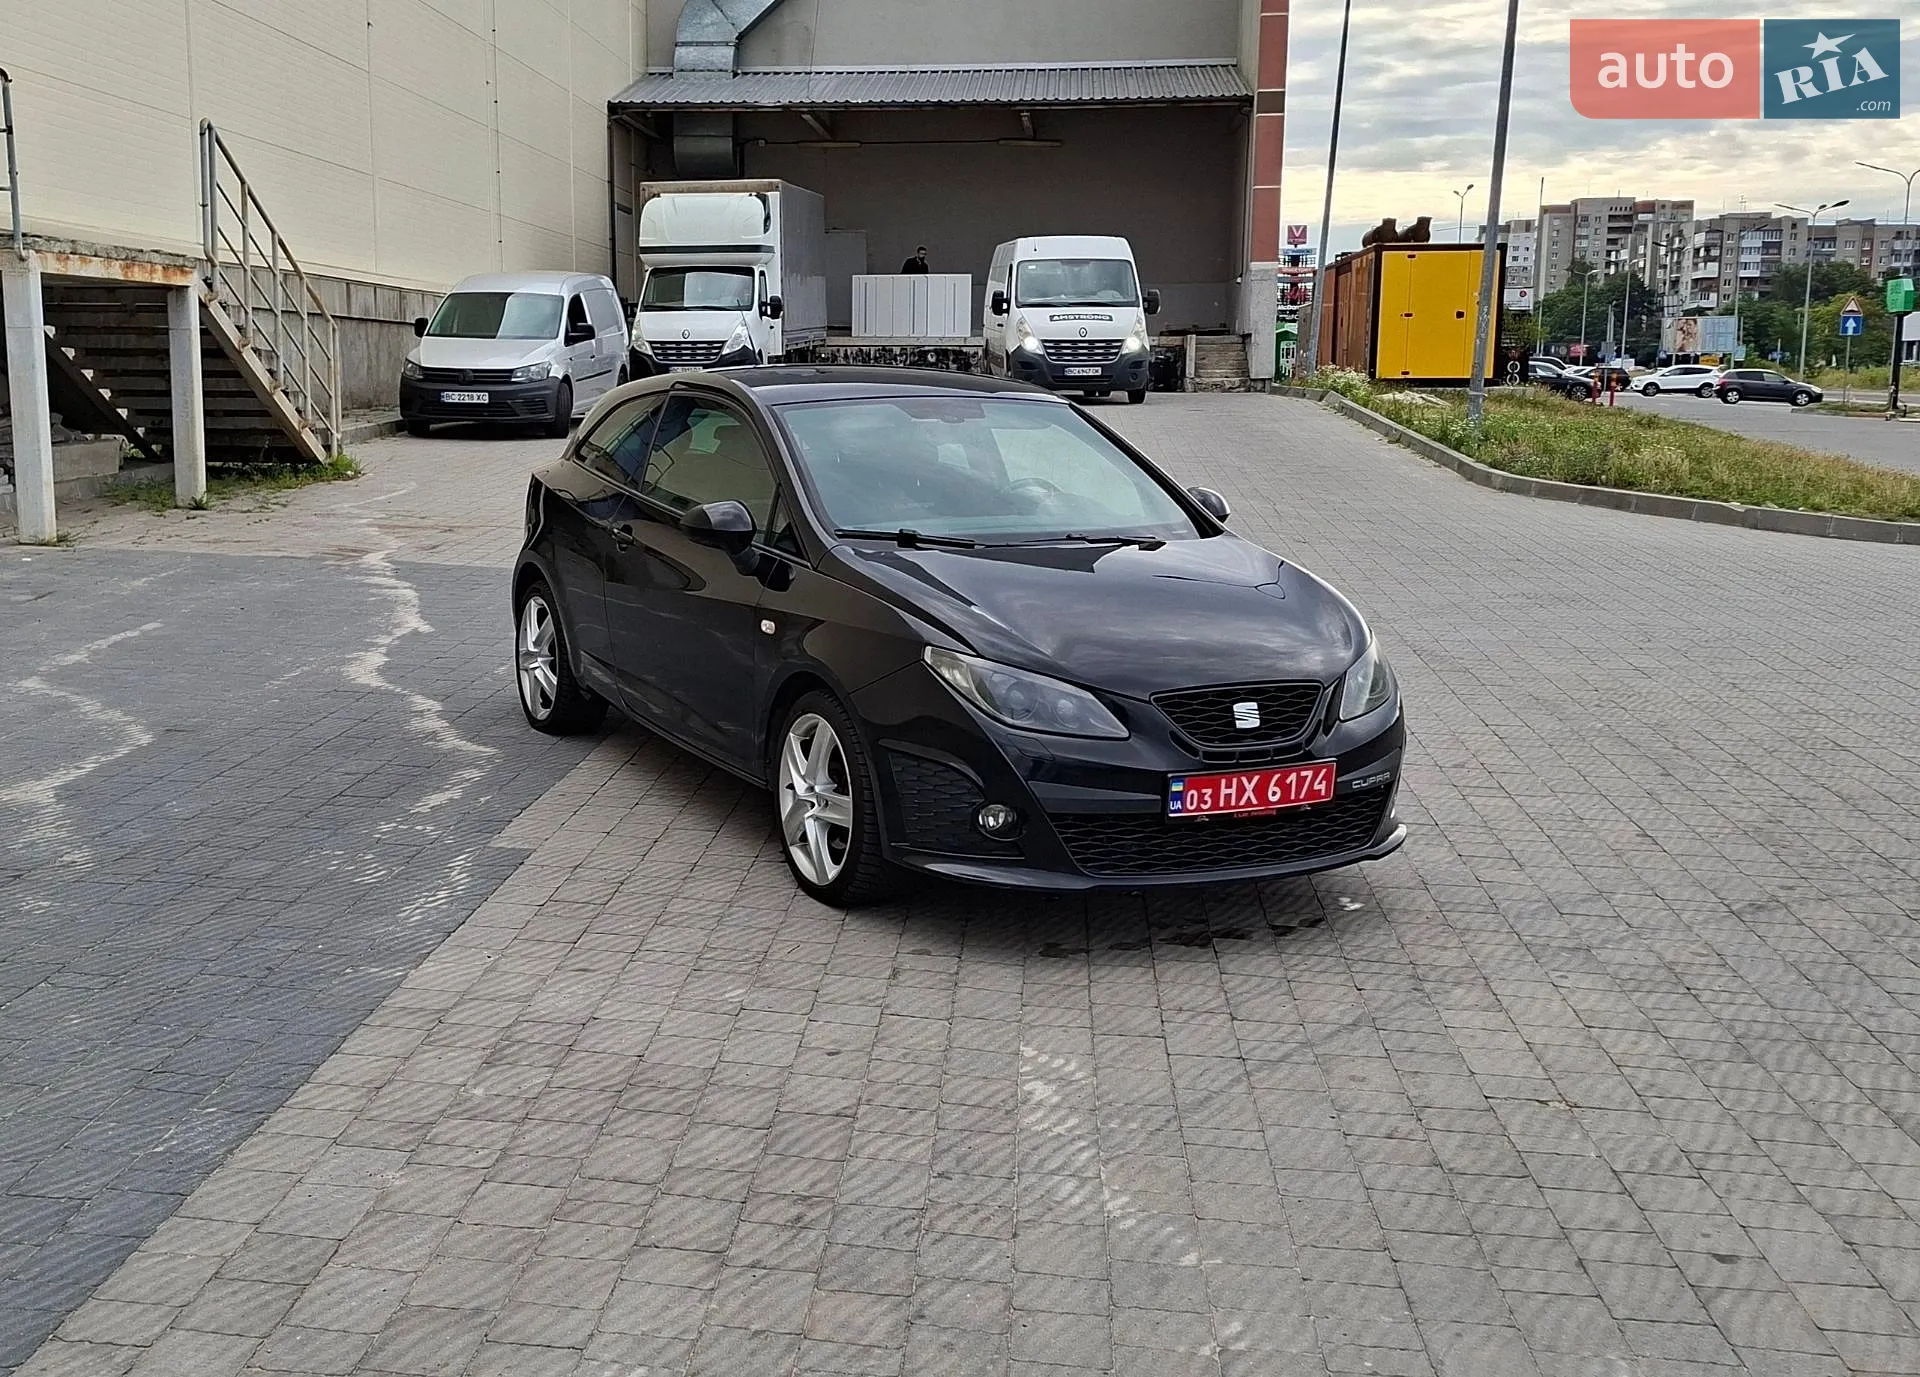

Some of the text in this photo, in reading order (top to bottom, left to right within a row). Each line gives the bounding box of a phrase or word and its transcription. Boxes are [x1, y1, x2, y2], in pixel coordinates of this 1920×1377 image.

[445, 393, 456, 401] BC
[476, 394, 488, 402] XC
[1352, 771, 1391, 789] CUPRA
[1186, 768, 1328, 811] 03 HX 6174
[1170, 800, 1182, 811] UA
